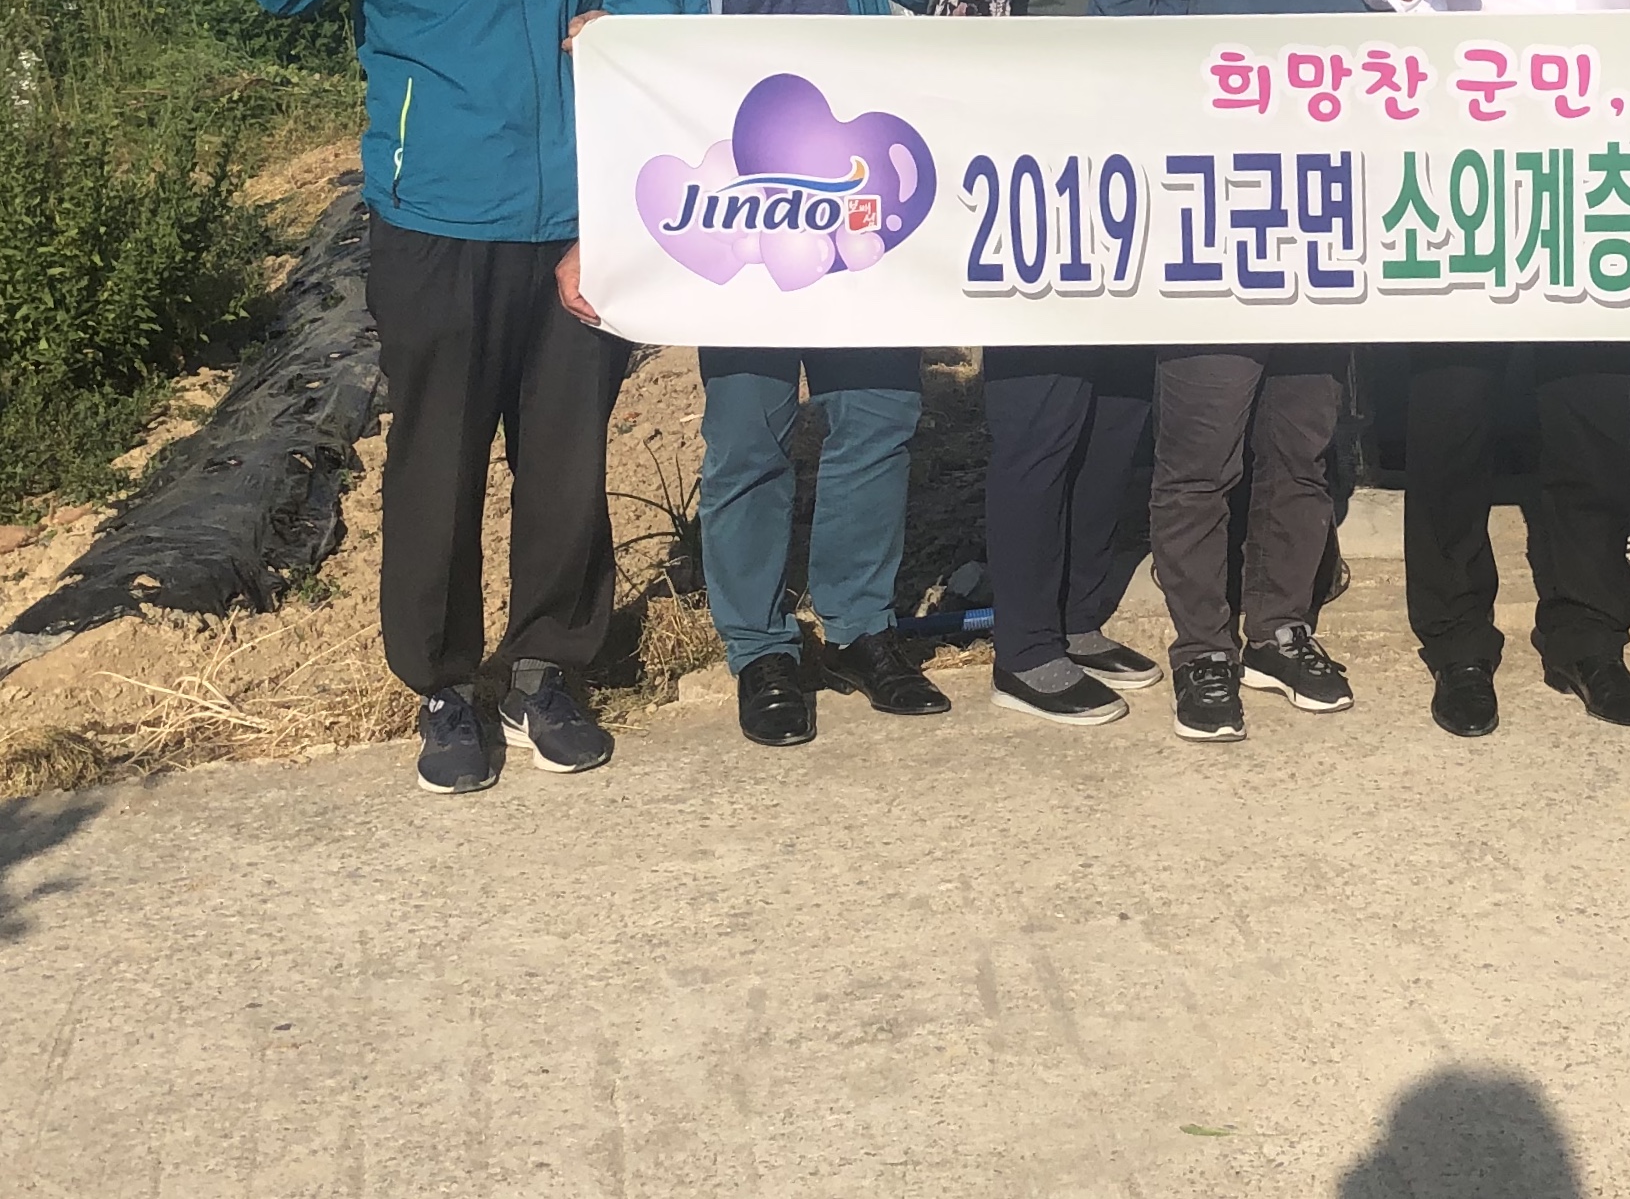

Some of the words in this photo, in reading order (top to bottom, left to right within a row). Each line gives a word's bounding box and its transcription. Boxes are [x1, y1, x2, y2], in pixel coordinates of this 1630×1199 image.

[1211, 51, 1427, 122] 희망찬
[1457, 49, 1624, 122] 군민,
[662, 184, 842, 232] Jindo
[962, 155, 1138, 284] 2019
[1163, 151, 1354, 290] 고군면
